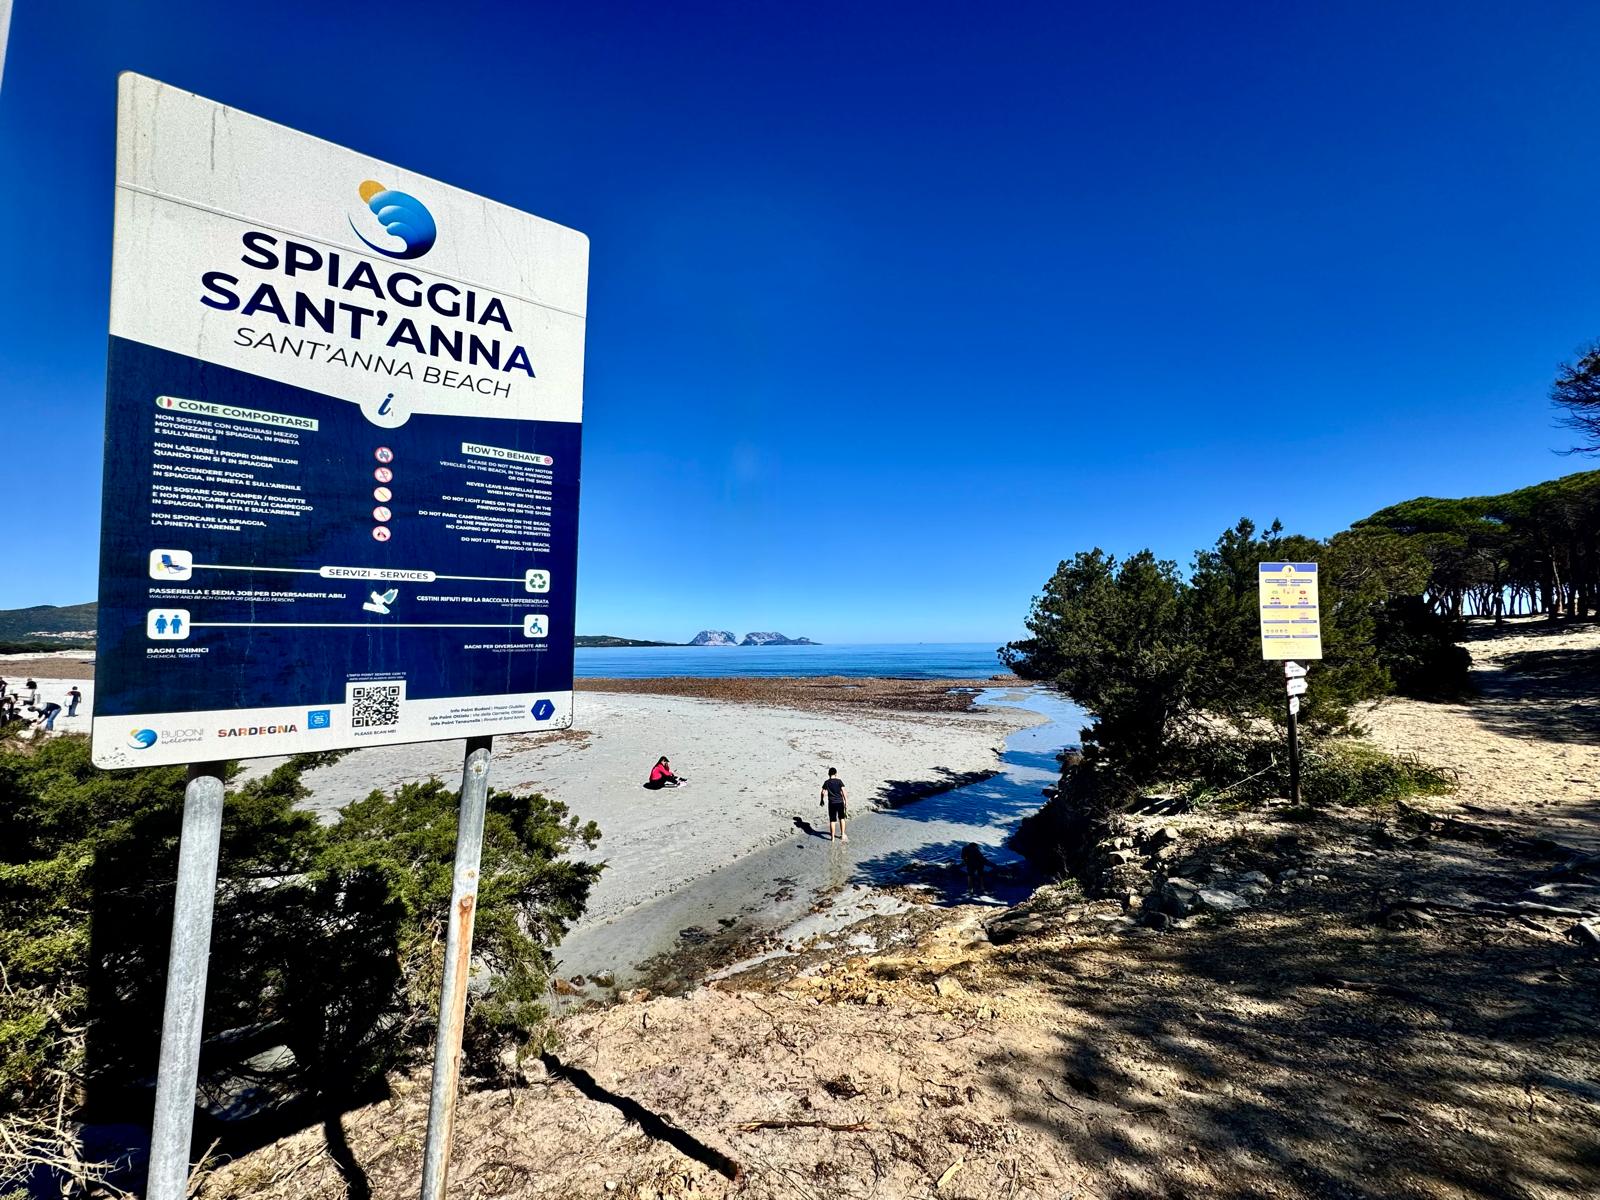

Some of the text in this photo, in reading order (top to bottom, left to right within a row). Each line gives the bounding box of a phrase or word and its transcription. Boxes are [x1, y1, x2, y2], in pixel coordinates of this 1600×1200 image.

[241, 231, 512, 332] SPIAGGIA
[200, 271, 535, 378] SANT'ANNA
[233, 327, 511, 399] SANT'ANNA BEACH
[179, 402, 312, 428] COME COMPORTARSI
[155, 421, 213, 434] MOTORIZZATO
[225, 430, 262, 440] SPIAGGIA,
[273, 436, 299, 445] PINETA
[156, 414, 298, 439] NON SOSTARE CON QUALSIASI MEZZO
[161, 429, 217, 441] SULL'ARENILE
[154, 450, 191, 459] QUANDO
[238, 459, 273, 468] SPIAGGIA
[174, 445, 214, 455] LASCIARE
[220, 450, 248, 459] PROPRI
[250, 454, 298, 464] OMBRELLONI
[468, 445, 540, 462] HOW TO BEHAVE
[163, 472, 204, 481] SPIAGGIA,
[216, 477, 243, 485] PINETA
[251, 480, 301, 490] SULL'ARENILE
[174, 466, 222, 476] ACCENDERE
[224, 471, 253, 479] FUOCHI
[173, 487, 209, 495] SOSTARE
[230, 492, 262, 500] CAMPER
[268, 495, 305, 504] ROULOTTE
[180, 494, 224, 503] PRATICARE
[226, 498, 259, 506] ATTIVITÀ
[270, 502, 313, 511] CAMPEGGIO
[162, 500, 203, 508] SPIAGGIA,
[250, 507, 300, 516] SULL'ARENILE
[172, 514, 215, 523] SPORCARE
[229, 518, 266, 527] SPIAGGIA,
[201, 523, 240, 531] L'ARENILE
[329, 569, 370, 577] SERVIZI
[379, 571, 428, 580] SERVICES
[162, 728, 204, 738] BUDONI
[218, 724, 298, 737] SARDEGNA
[162, 737, 203, 745] welcome
